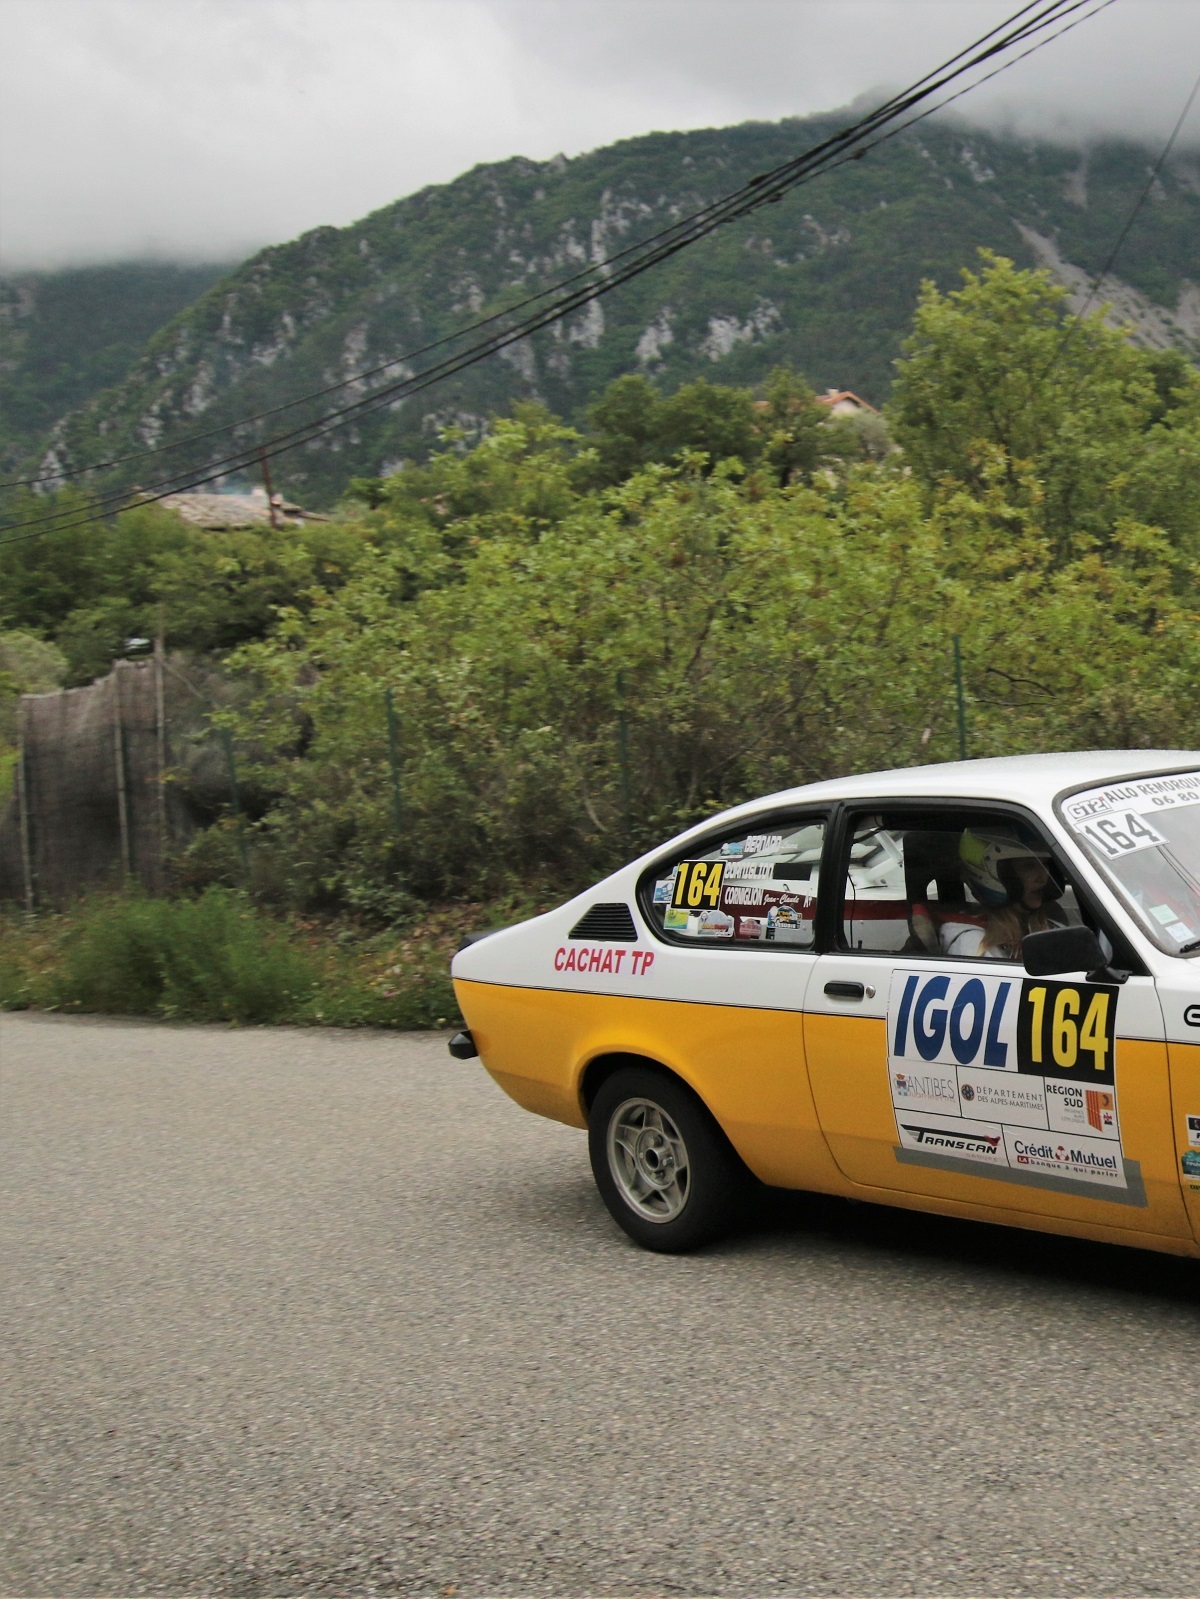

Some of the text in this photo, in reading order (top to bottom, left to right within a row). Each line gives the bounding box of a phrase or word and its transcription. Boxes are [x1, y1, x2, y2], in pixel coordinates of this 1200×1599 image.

[1104, 787, 1139, 803] ALLO
[1151, 795, 1175, 806] 06
[1177, 791, 1199, 801] 80
[1085, 813, 1161, 855] 164
[674, 862, 724, 907] 164
[724, 886, 764, 906] CORNIGLION
[554, 947, 655, 976] CACHAT TP
[893, 975, 1012, 1068] IGOL
[1028, 986, 1110, 1071] 164
[907, 1075, 955, 1099] ANTIBES
[976, 1085, 1044, 1102] DÉPARTEMENT
[977, 1095, 1045, 1111] DES ALPES-MARITIMES
[1064, 1097, 1084, 1108] SUD
[1014, 1140, 1117, 1169] Crédit Mutuel
[1030, 1159, 1061, 1169] banque
[1090, 1169, 1118, 1178] parler
